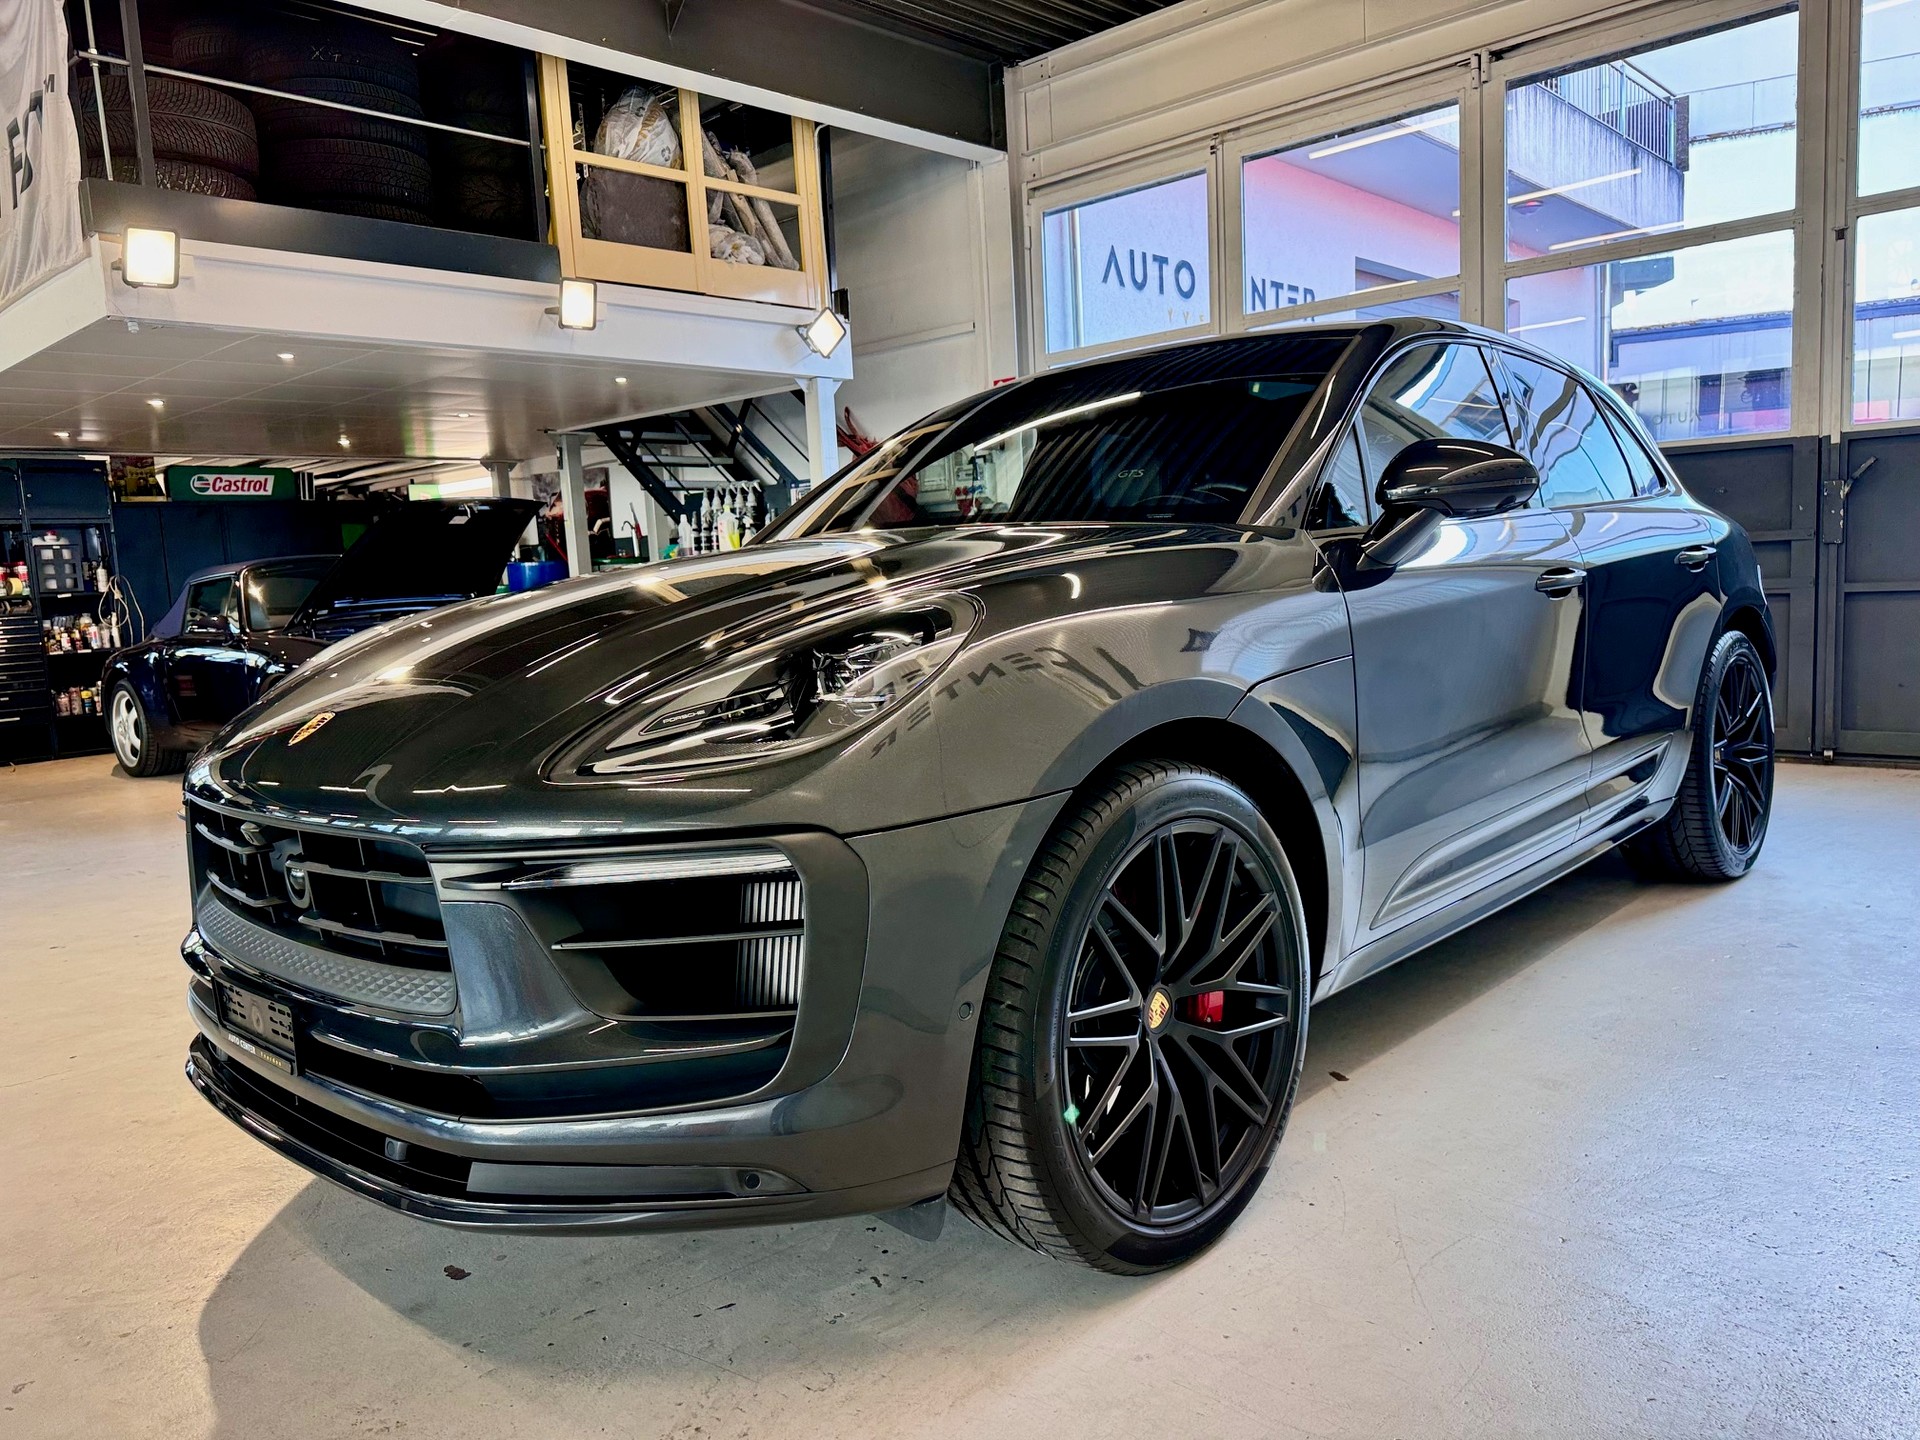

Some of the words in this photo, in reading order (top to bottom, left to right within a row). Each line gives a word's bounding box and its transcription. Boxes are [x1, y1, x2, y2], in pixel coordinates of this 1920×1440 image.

[1101, 244, 1196, 300] AUTO
[1250, 275, 1316, 322] NTER
[1117, 468, 1145, 479] GTS
[211, 476, 269, 493] Castrol
[662, 708, 707, 725] PORSCHE
